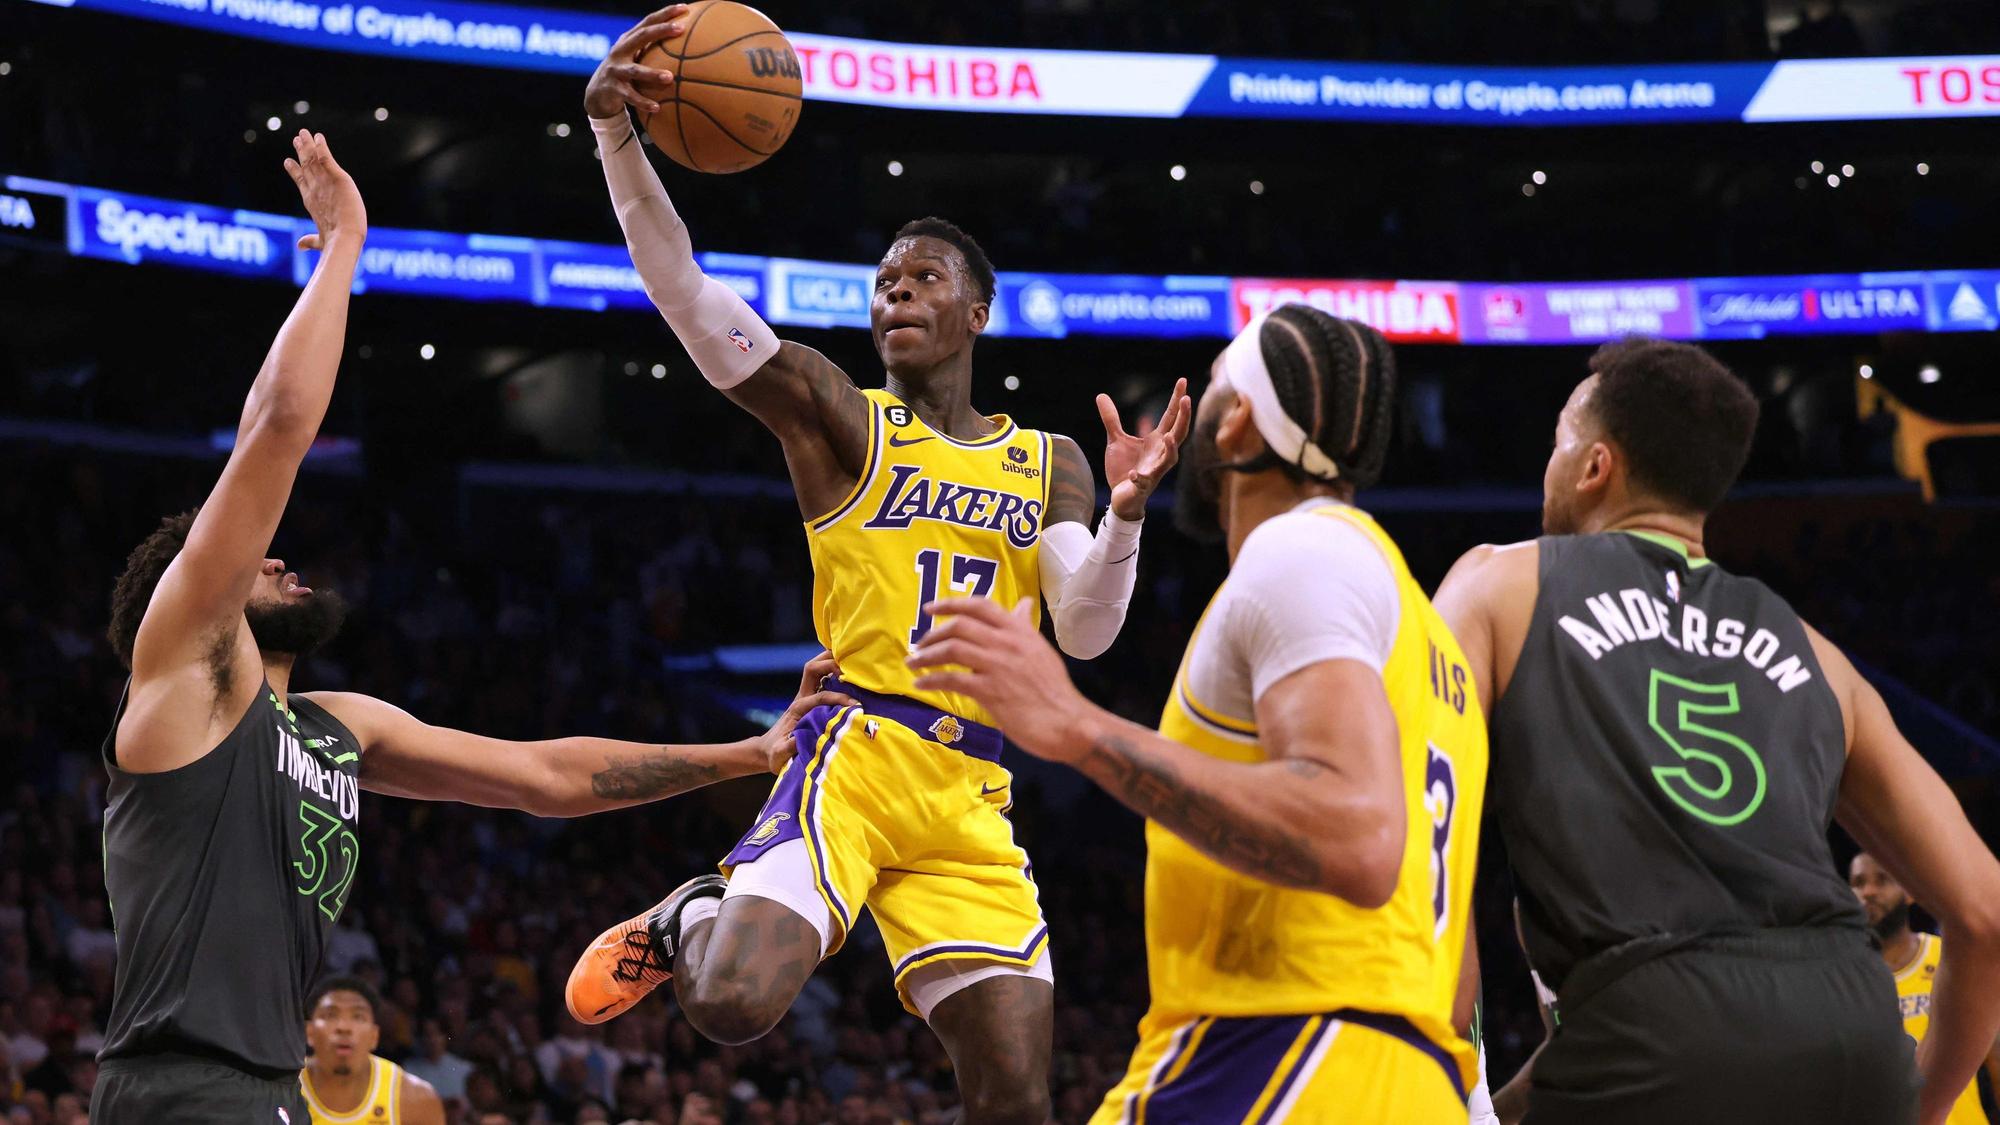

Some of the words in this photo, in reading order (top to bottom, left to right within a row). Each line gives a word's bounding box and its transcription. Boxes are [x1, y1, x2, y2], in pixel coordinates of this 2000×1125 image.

[322, 3, 353, 36] of
[355, 6, 523, 47] Crypto.com
[525, 22, 610, 61] Arena
[796, 46, 1041, 97] TOSHIBA
[1229, 72, 1318, 104] Printer
[1320, 75, 1431, 108] Provider
[1433, 80, 1463, 110] of
[1464, 80, 1626, 116] Crypto.com
[1629, 79, 1715, 109] Arena
[96, 198, 269, 264] Spectrum
[363, 248, 515, 284] crypto.com
[791, 277, 868, 311] UCLA
[1061, 293, 1211, 323] crypto.com
[1820, 287, 1920, 319] ULTRA
[890, 408, 907, 425] 6
[1001, 460, 1040, 479] bibigo
[863, 465, 1042, 548] LAKERS
[909, 548, 999, 656] 17
[1558, 587, 1811, 693] ANDERSON
[1648, 668, 1767, 826] 5
[294, 800, 359, 922] 32
